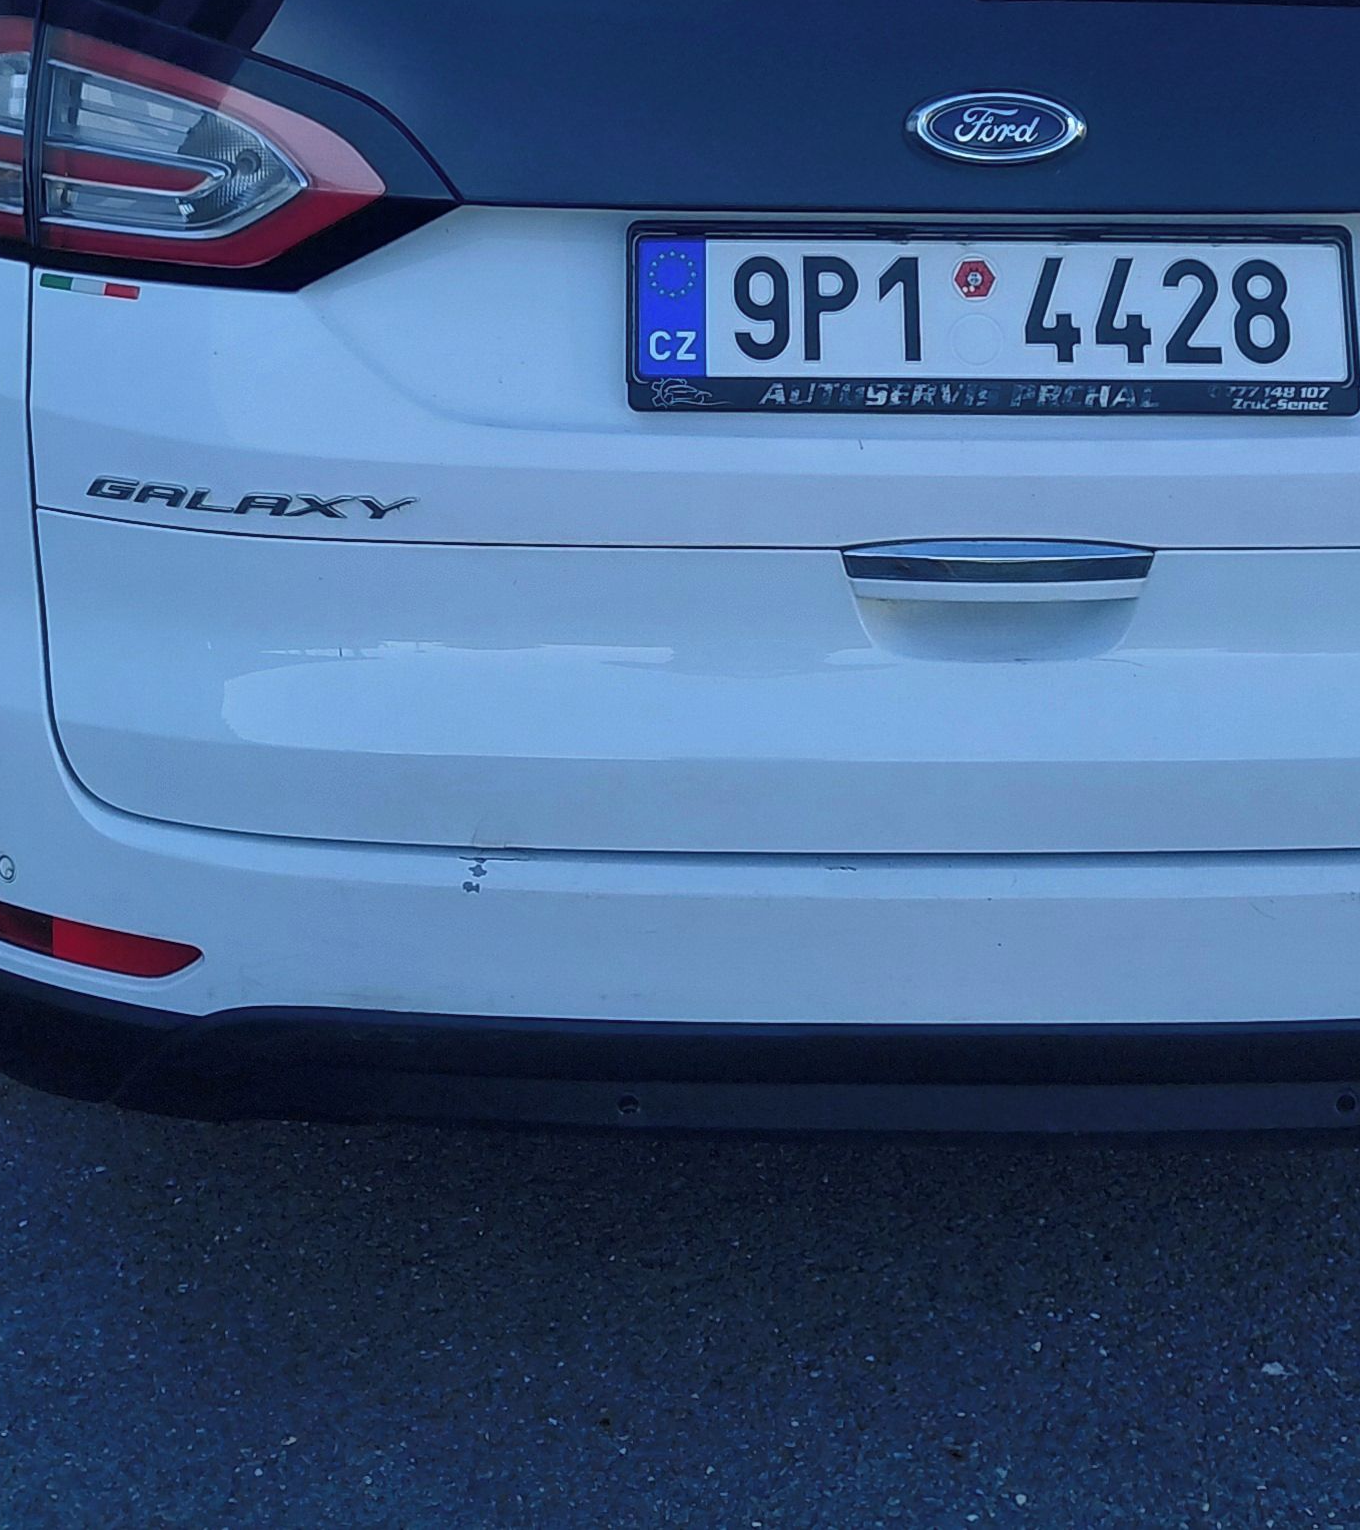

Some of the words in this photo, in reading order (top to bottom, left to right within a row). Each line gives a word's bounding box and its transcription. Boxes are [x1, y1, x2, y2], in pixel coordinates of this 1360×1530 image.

[954, 106, 1040, 143] Ford
[733, 255, 923, 362] 9P1
[1023, 257, 1293, 365] 4428
[649, 330, 697, 361] CZ
[1264, 386, 1296, 398] 148
[1300, 386, 1331, 399] 107
[85, 474, 420, 520] GALAXY
